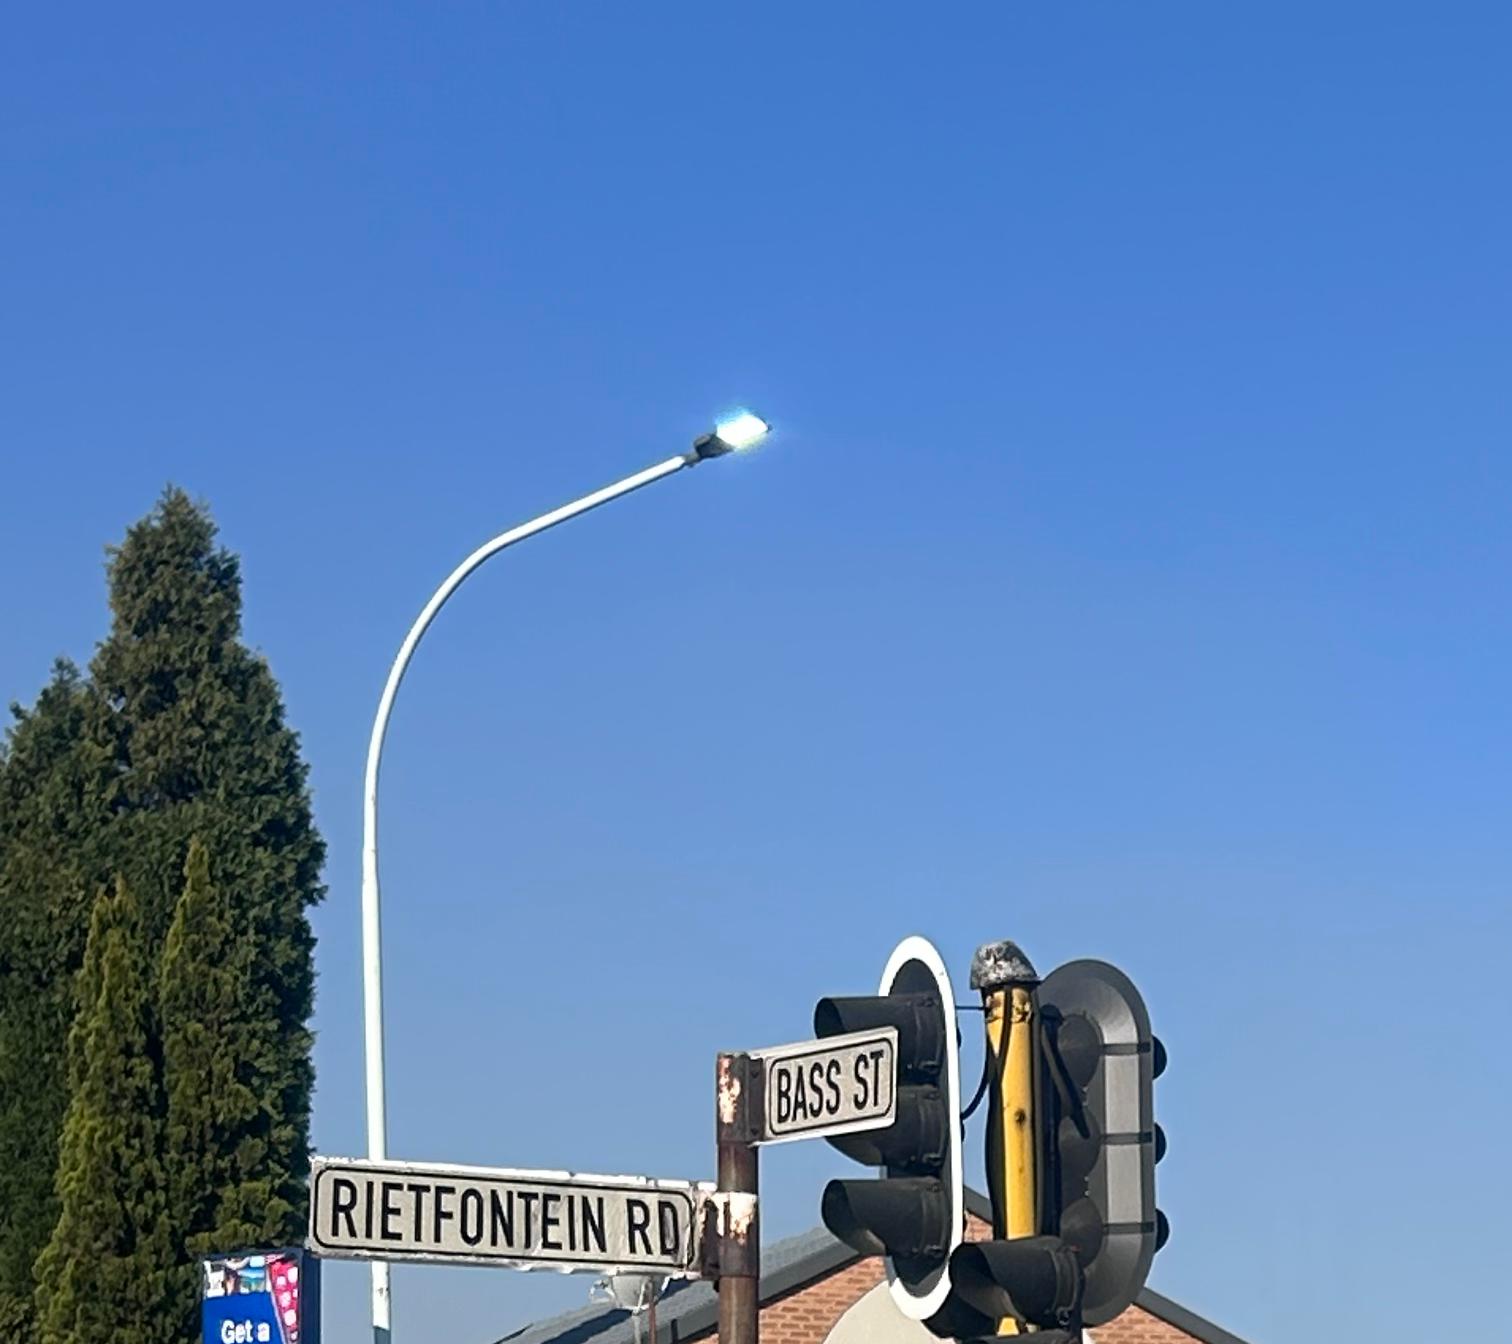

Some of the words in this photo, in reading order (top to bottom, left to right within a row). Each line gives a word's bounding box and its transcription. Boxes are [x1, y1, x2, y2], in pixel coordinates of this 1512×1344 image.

[778, 1059, 840, 1123] BASS
[853, 1050, 884, 1110] ST
[331, 1178, 607, 1253] RIETFONTEIN
[626, 1198, 681, 1256] RD
[222, 1320, 253, 1344] Get
[257, 1322, 270, 1342] a
